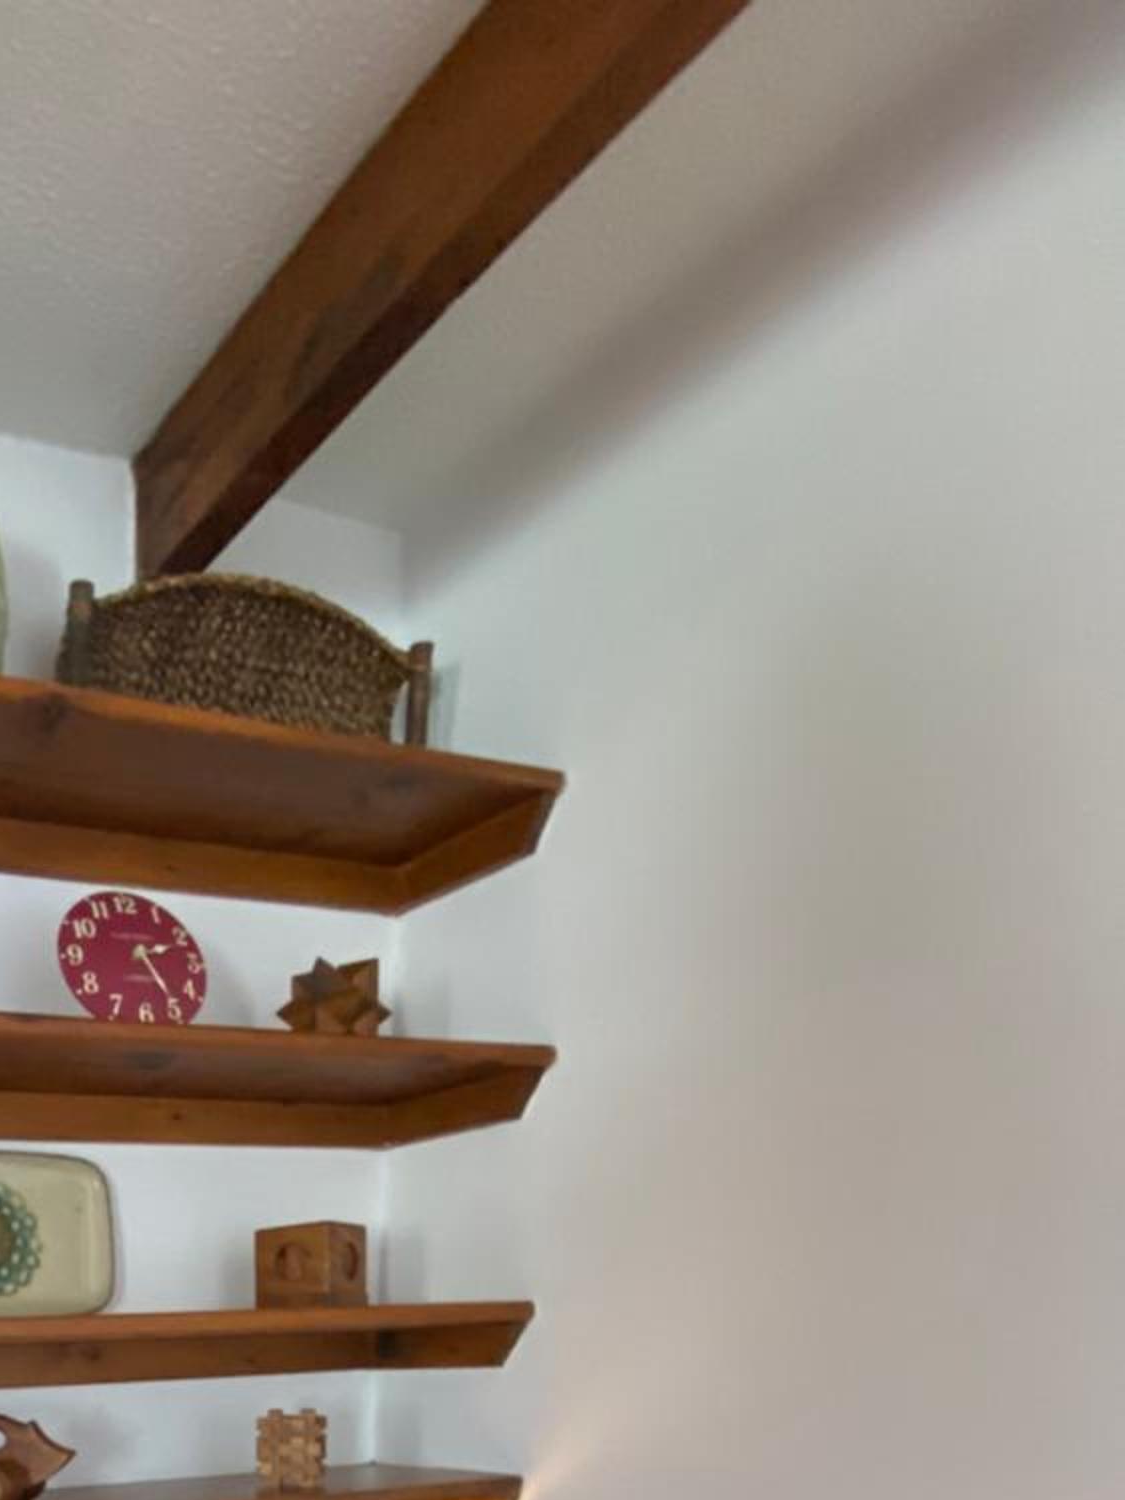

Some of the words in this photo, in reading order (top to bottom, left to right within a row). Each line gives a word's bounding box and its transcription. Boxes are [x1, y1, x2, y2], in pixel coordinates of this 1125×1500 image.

[90, 899, 109, 920] 11
[112, 895, 138, 914] 12
[150, 906, 161, 924] 1
[73, 918, 96, 939] 10
[172, 927, 187, 947] 2
[66, 943, 84, 966] 9
[81, 971, 100, 994] 8
[183, 979, 196, 1000] 4
[109, 993, 123, 1016] 7
[138, 1002, 155, 1023] 6
[167, 997, 182, 1020] 5
